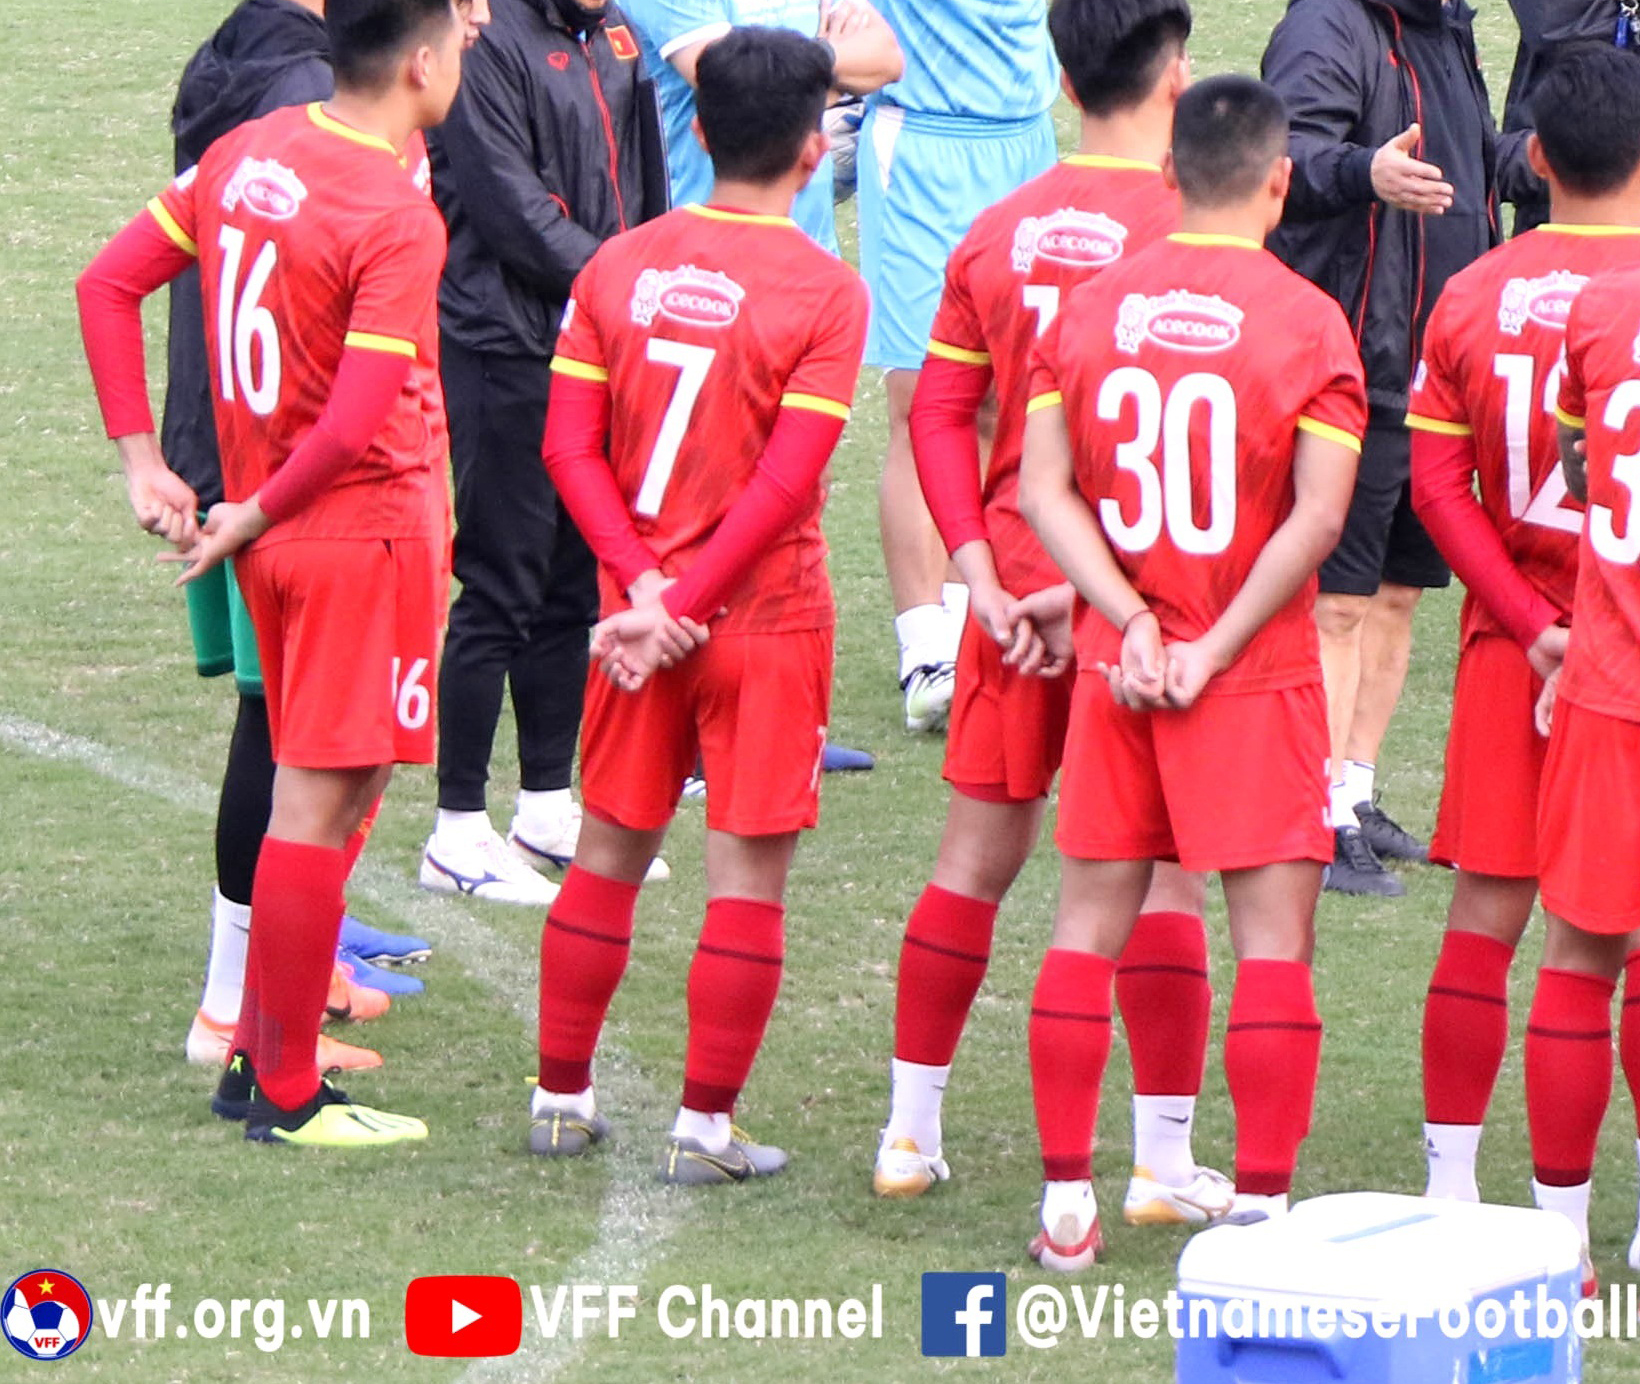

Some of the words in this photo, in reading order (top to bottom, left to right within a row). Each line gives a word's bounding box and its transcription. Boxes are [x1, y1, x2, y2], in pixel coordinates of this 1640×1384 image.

[217, 223, 282, 416] 16
[636, 337, 716, 519] 7
[1096, 366, 1238, 555] 30
